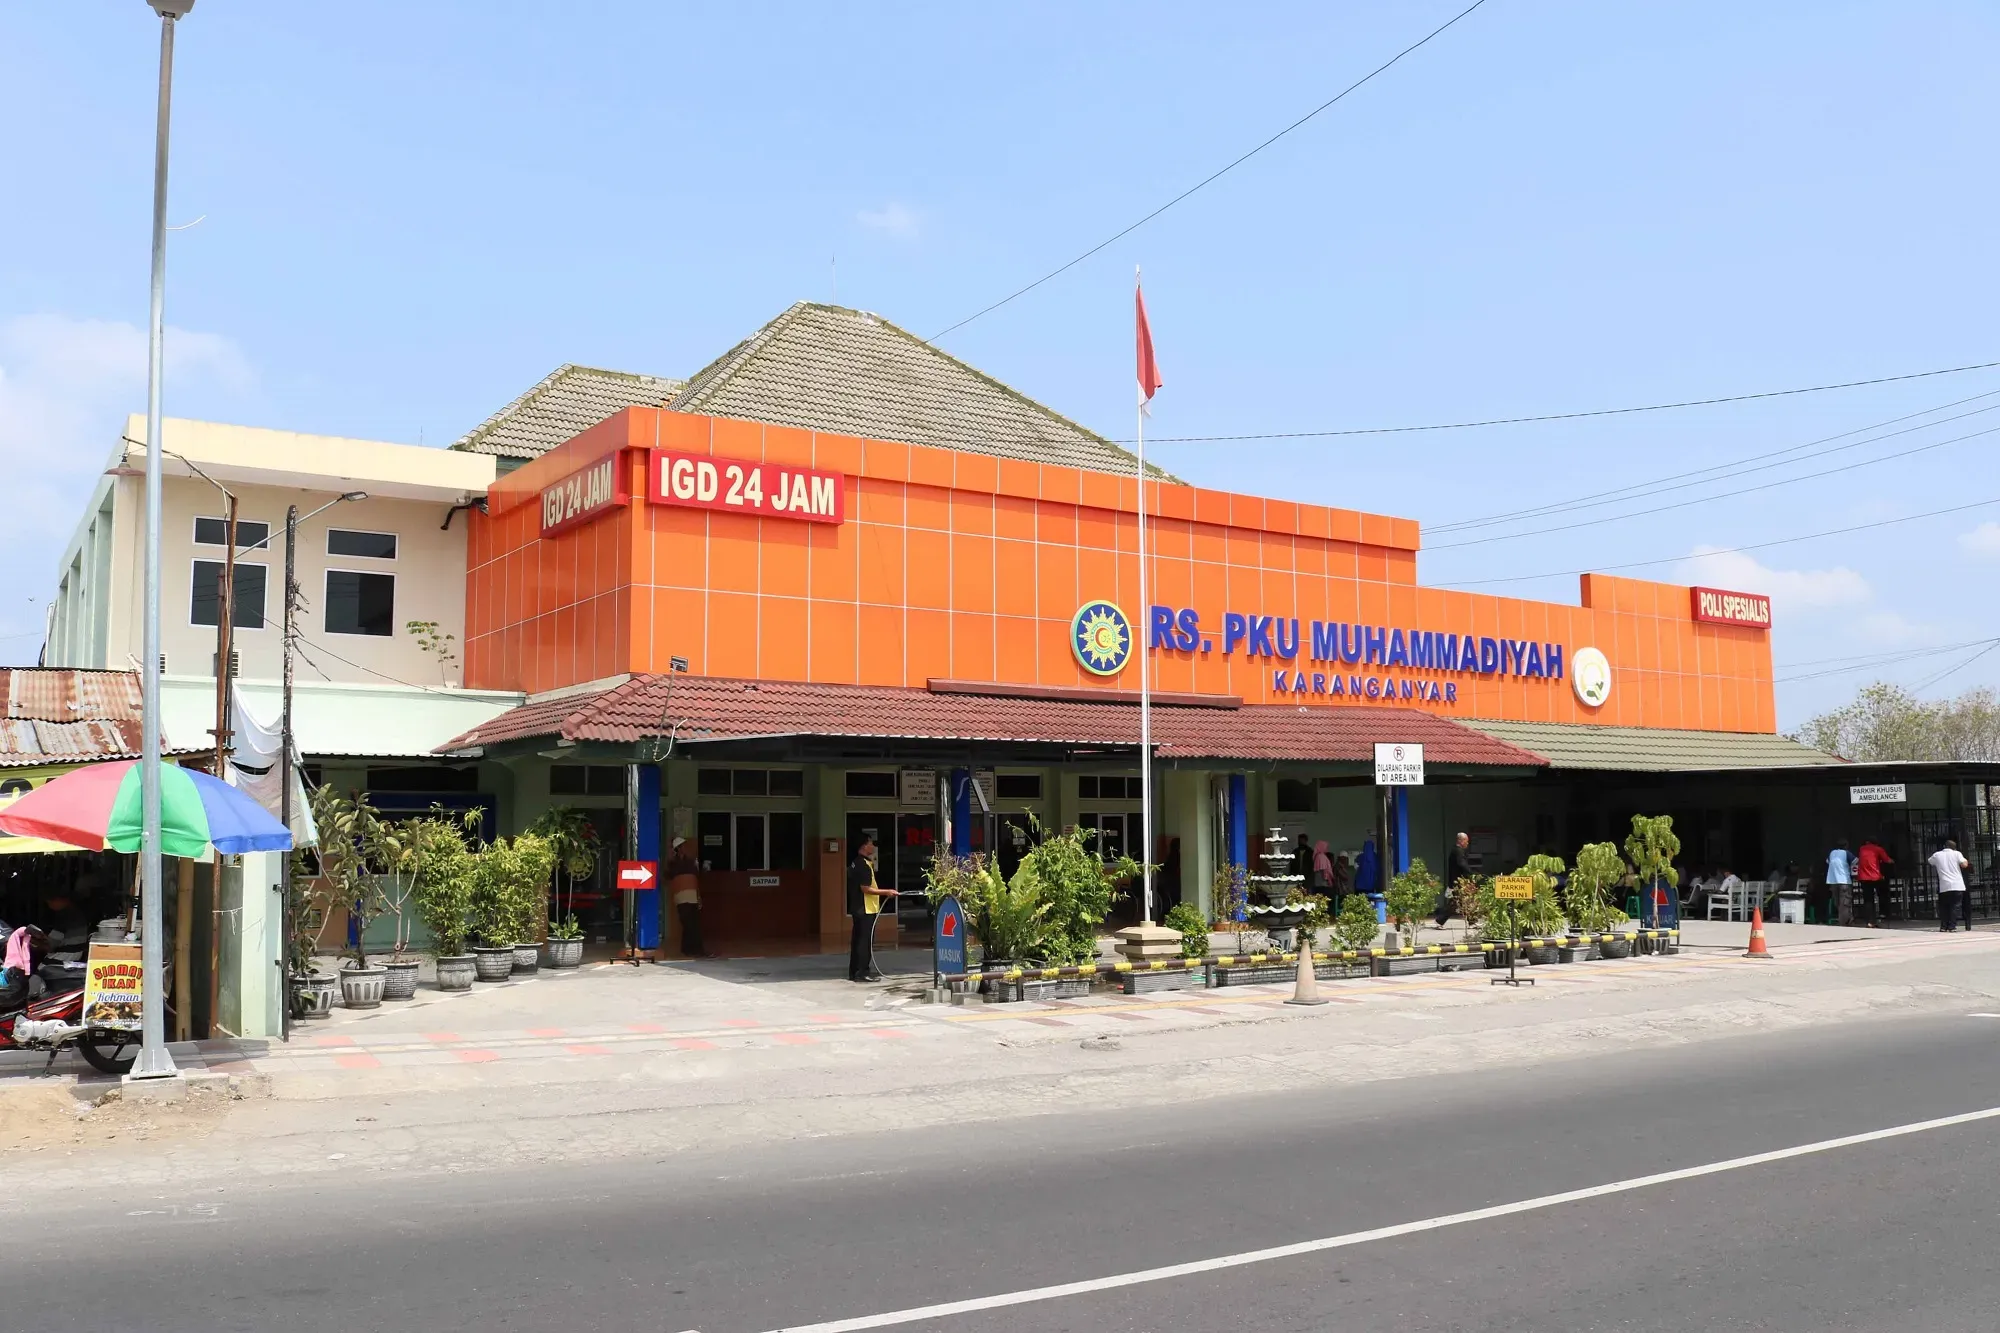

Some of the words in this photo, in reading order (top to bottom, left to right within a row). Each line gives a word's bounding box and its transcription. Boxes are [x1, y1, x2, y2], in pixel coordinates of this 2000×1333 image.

[543, 488, 563, 530] IGD
[566, 477, 582, 519] 24
[583, 460, 612, 510] JAM
[660, 456, 718, 503] IGD
[725, 467, 763, 507] 24
[770, 472, 835, 516] JAM
[1701, 592, 1722, 618] POLI
[1724, 595, 1769, 623] SPESIALIS
[1149, 605, 1212, 653] RS.
[1222, 611, 1299, 659] PKU
[1310, 620, 1563, 679] MUHAMMADIYAH
[1273, 670, 1457, 699] KARANGANYAR
[1377, 764, 1402, 772] DILARANG
[1403, 764, 1421, 772] PARKIR
[1382, 773, 1388, 782] DI
[1390, 773, 1407, 782] AREA
[1409, 774, 1417, 782] INI
[1859, 793, 1898, 801] AMBULANCE
[939, 948, 961, 963] MASUK
[102, 979, 136, 989] IKAN
